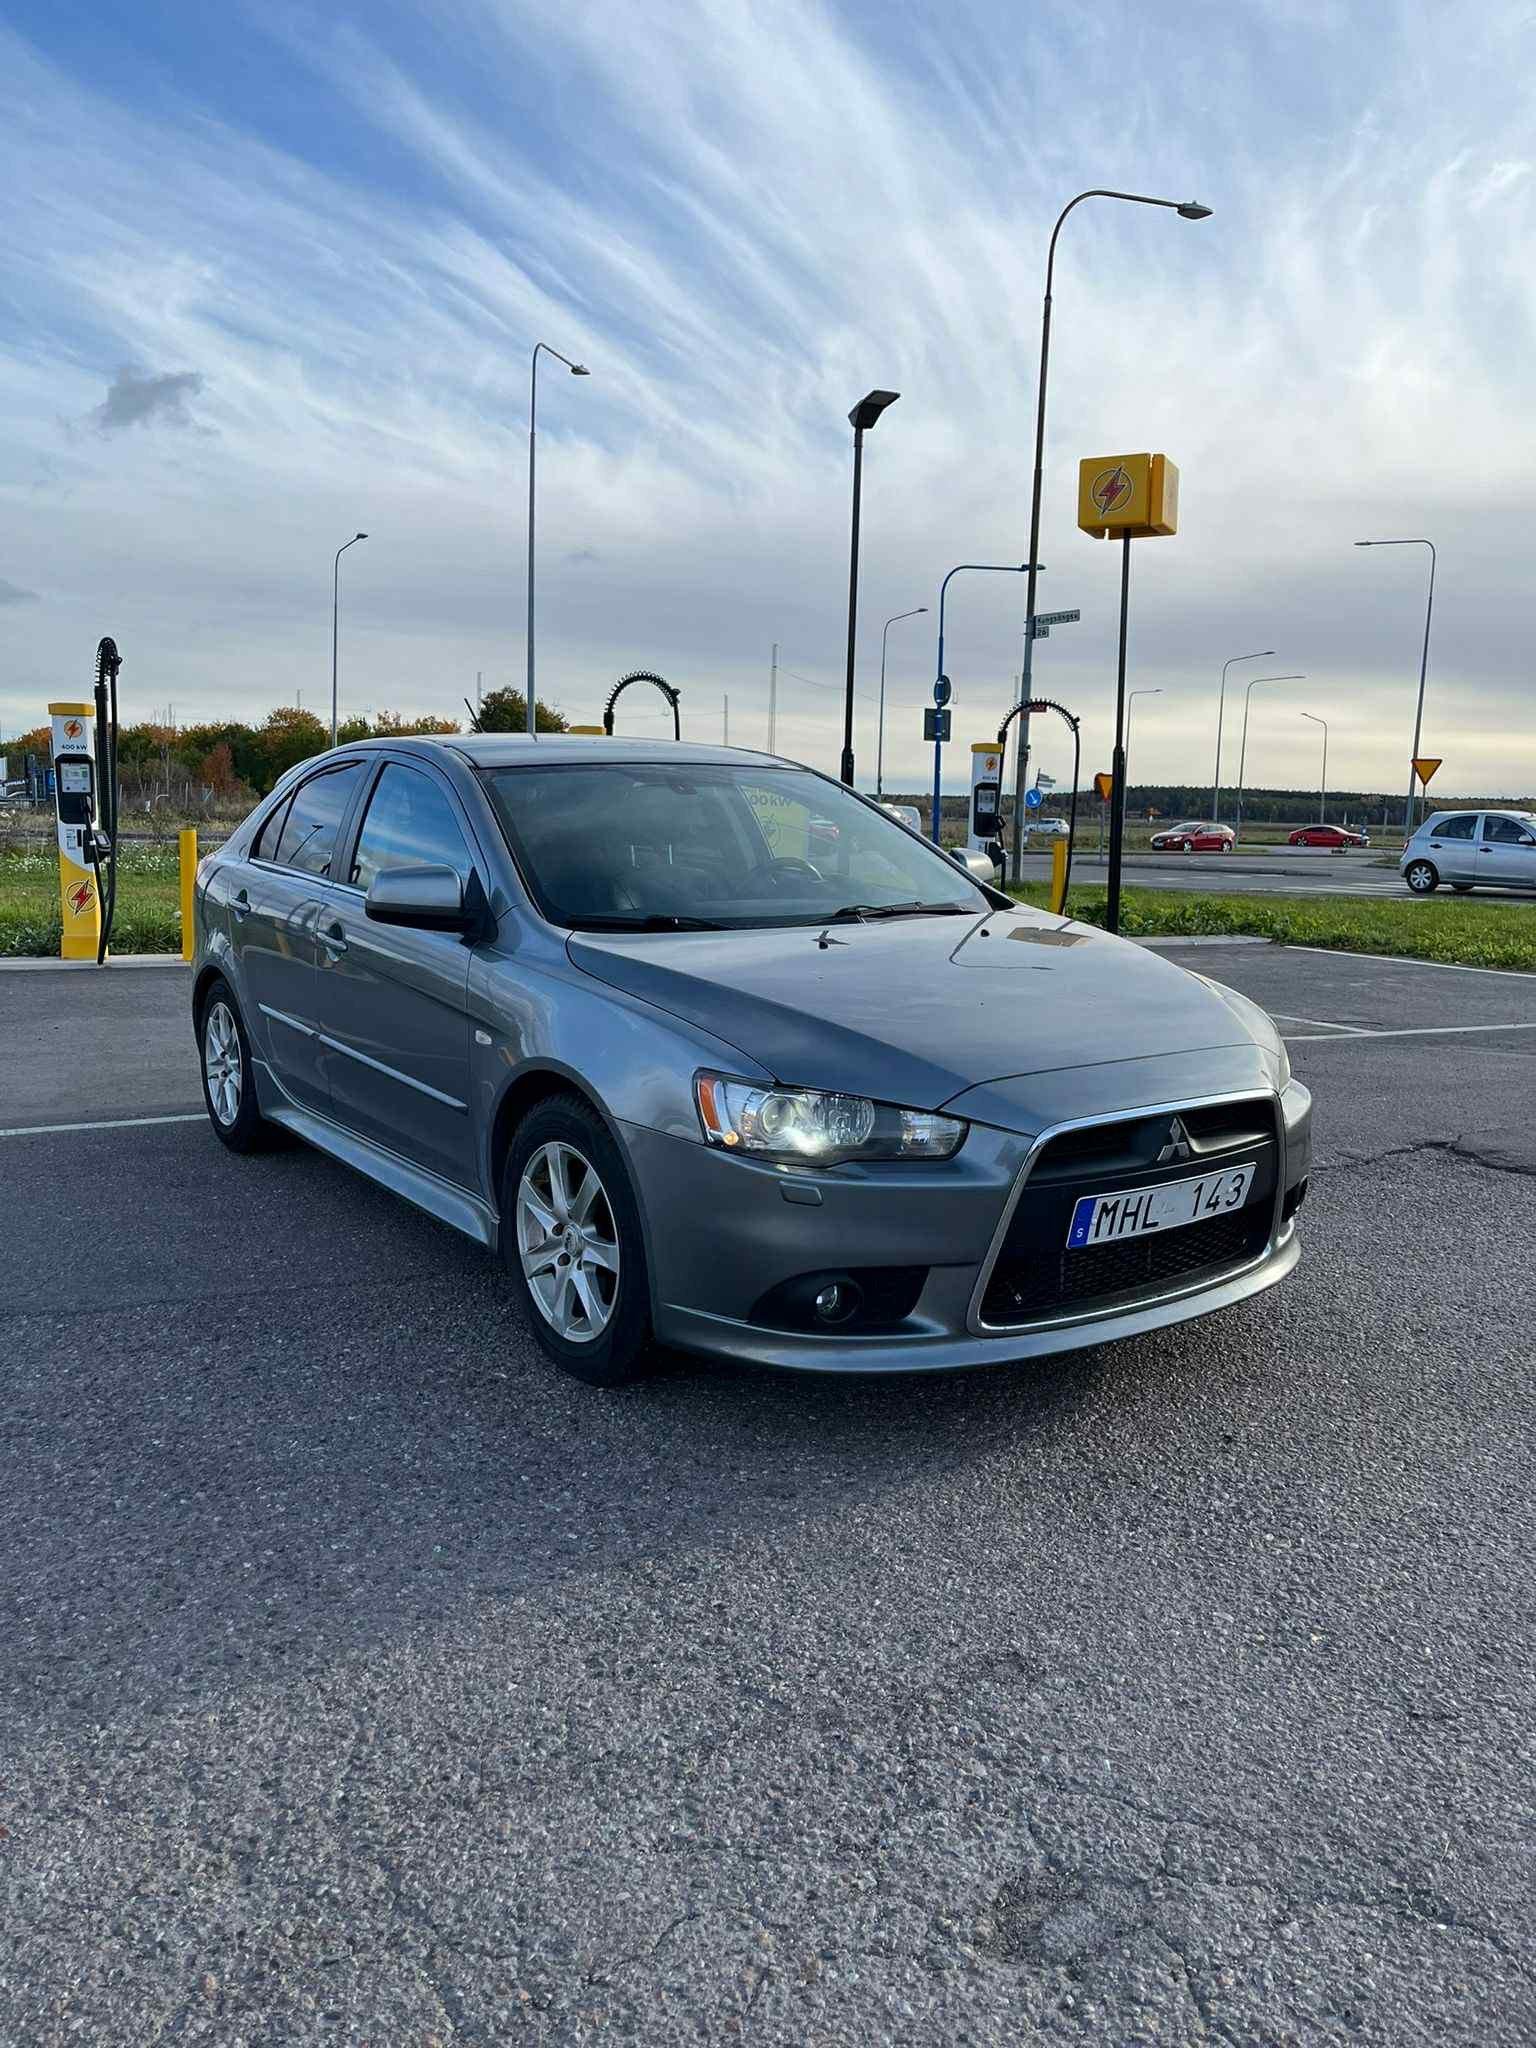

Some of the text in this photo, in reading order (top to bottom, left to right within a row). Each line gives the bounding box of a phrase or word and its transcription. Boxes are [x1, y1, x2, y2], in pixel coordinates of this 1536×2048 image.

[1094, 1173, 1246, 1238] MHL 143
[1076, 1227, 1085, 1239] S
